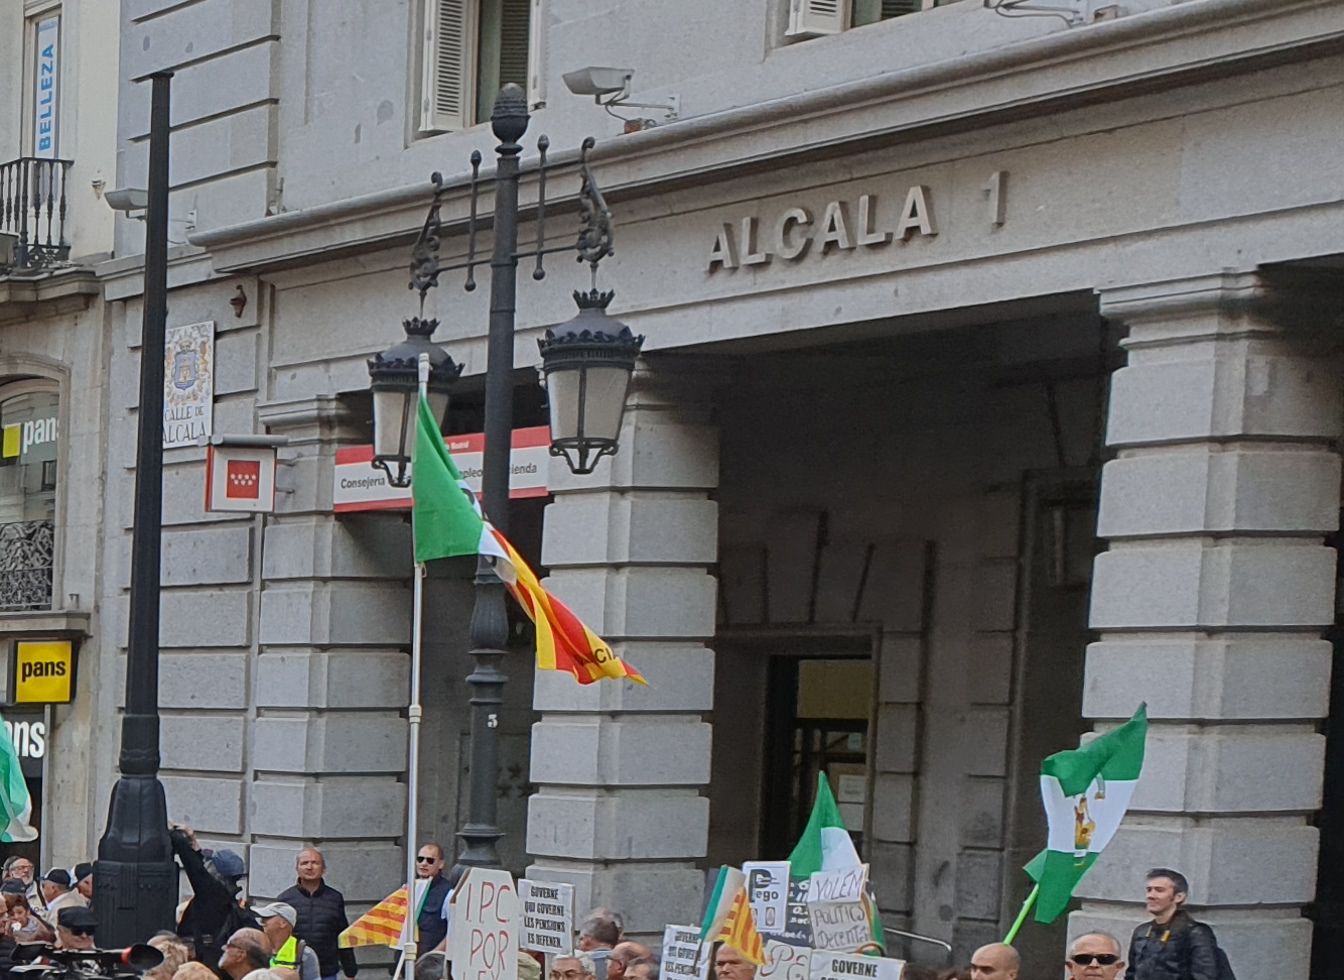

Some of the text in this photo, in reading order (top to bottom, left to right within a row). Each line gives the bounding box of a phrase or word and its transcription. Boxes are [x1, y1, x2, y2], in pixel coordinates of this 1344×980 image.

[39, 44, 54, 151] BELLEZA
[707, 170, 1009, 273] ALCALA 1
[164, 406, 204, 421] CALLE DE
[21, 658, 66, 683] pans
[530, 886, 560, 900] GOVERNE
[816, 872, 864, 901] VOLEM
[524, 901, 565, 917] QUI GOVERNE
[524, 916, 565, 933] LES PENSIONS
[527, 932, 535, 944] ES
[470, 929, 509, 970] POR
[832, 959, 878, 978] GOVERNE
